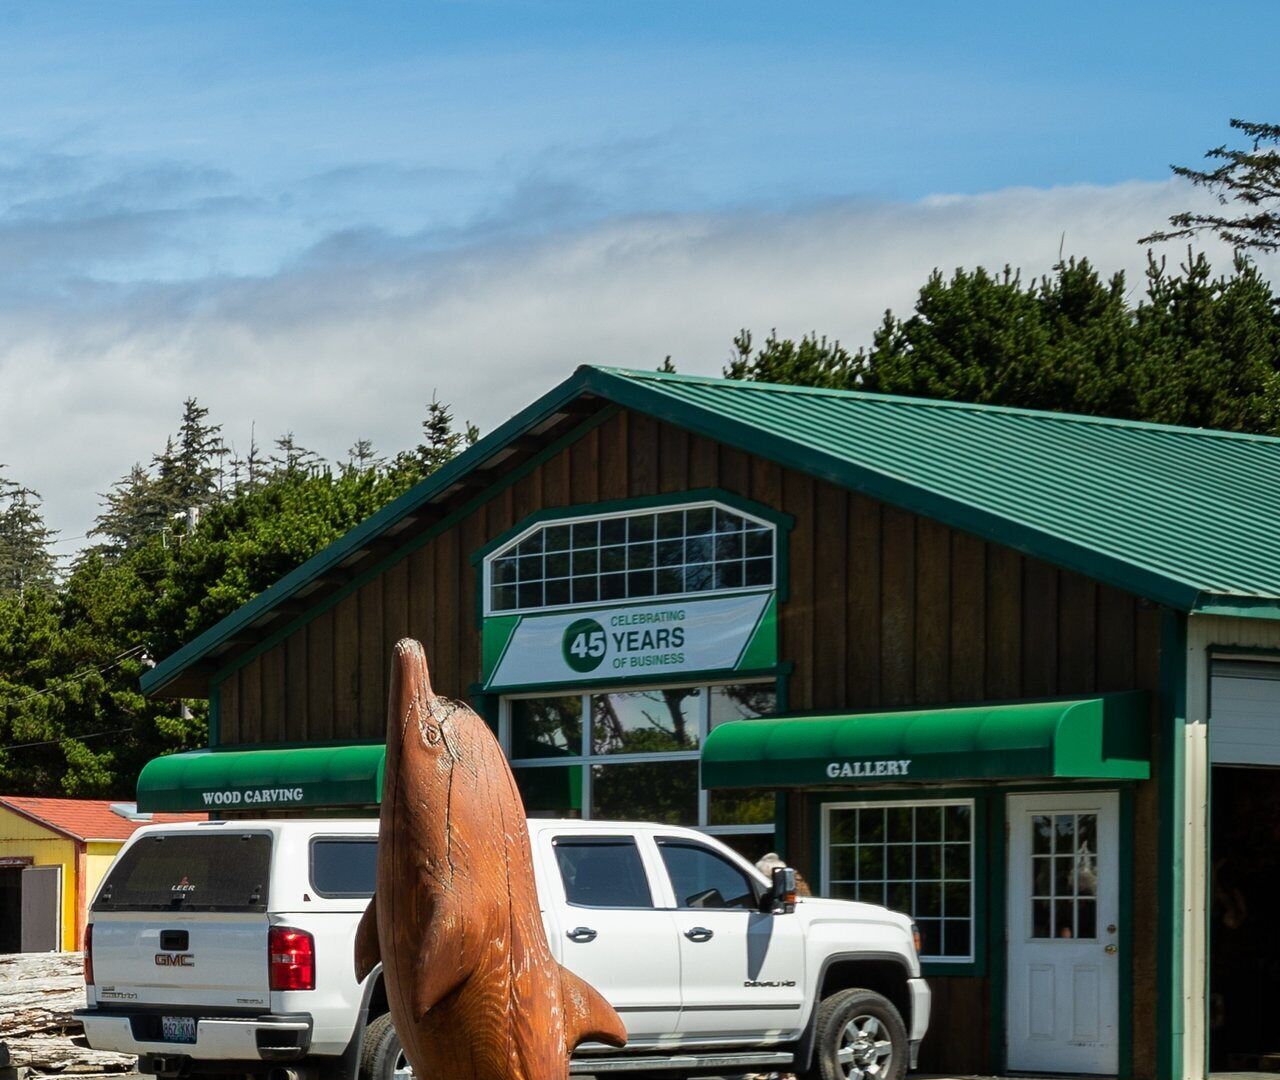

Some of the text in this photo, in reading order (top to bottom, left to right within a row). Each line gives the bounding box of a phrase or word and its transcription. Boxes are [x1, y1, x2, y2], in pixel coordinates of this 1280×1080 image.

[610, 610, 686, 627] CELEBRATING
[570, 631, 606, 658] 45
[612, 627, 685, 652] YEARS
[612, 653, 685, 669] OF BUSINESS
[826, 760, 911, 777] GALLERY
[202, 788, 304, 805] WOOD CARVING
[171, 884, 195, 892] LEER
[155, 954, 195, 967] GMC
